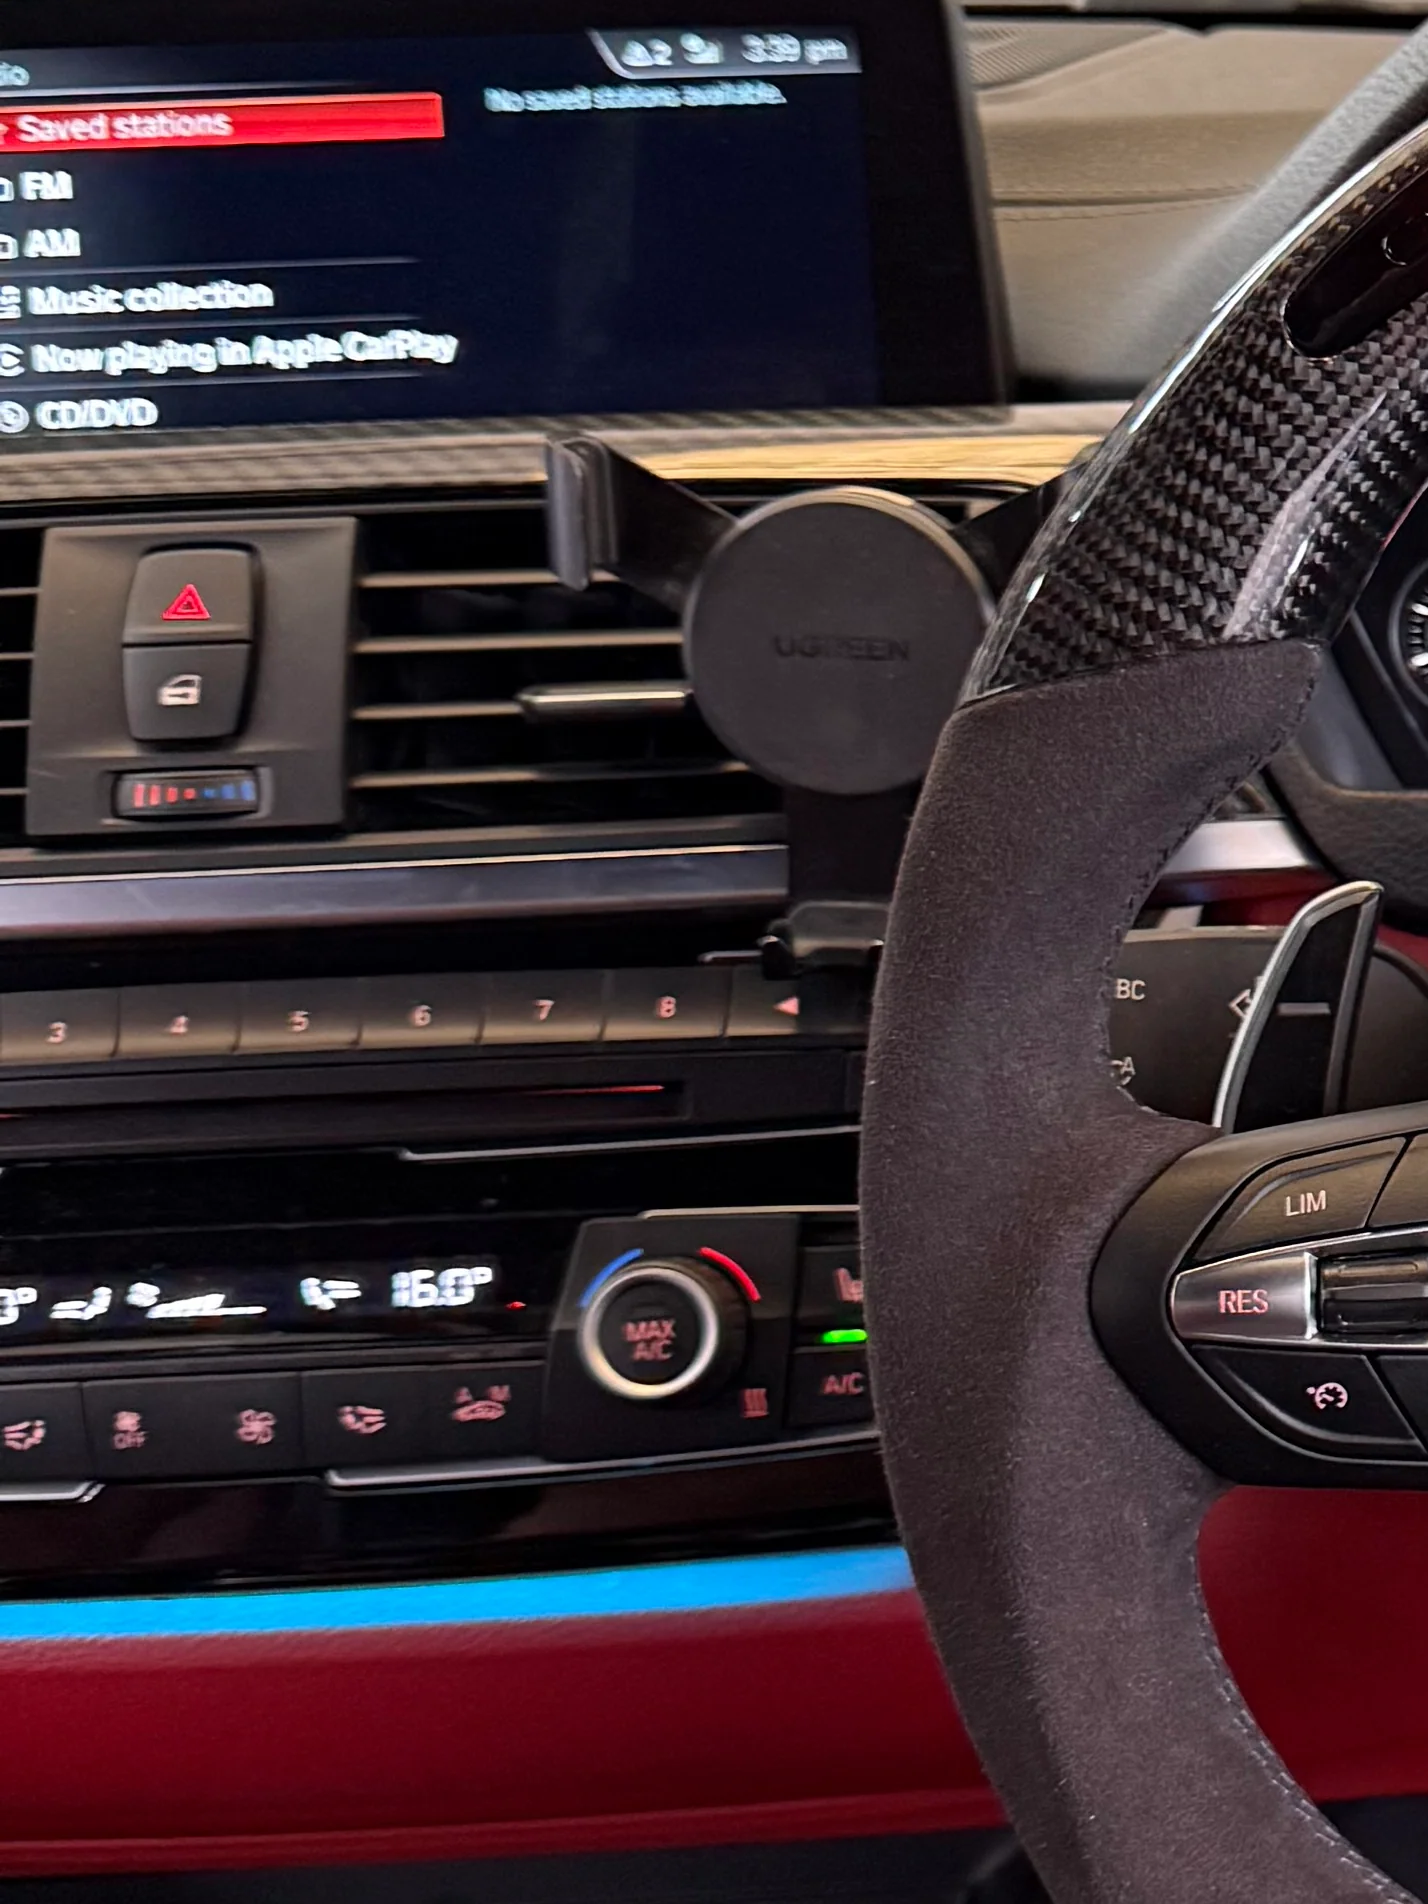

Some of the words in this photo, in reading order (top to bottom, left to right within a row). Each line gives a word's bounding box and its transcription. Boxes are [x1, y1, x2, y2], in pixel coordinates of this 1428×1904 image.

[15, 113, 108, 143] Saved
[112, 109, 233, 139] stations
[21, 170, 73, 201] FM
[24, 228, 81, 258] AM
[28, 284, 124, 315] Music
[124, 279, 275, 312] collection
[30, 343, 103, 373] Now
[103, 339, 218, 376] playing
[216, 337, 251, 366] in
[251, 334, 343, 370] Apple
[340, 329, 459, 364] CarPlay
[35, 397, 158, 430] CD/DVD
[1116, 978, 1145, 1000] BC
[411, 1004, 432, 1027] 6
[534, 999, 555, 1021] 7
[656, 996, 677, 1018] 8
[46, 1021, 67, 1044] 3
[288, 1010, 310, 1032] 5
[1286, 1190, 1327, 1217] LIM
[1219, 1289, 1269, 1314] RES
[623, 1318, 676, 1343] MAX
[823, 1372, 865, 1394] A/C
